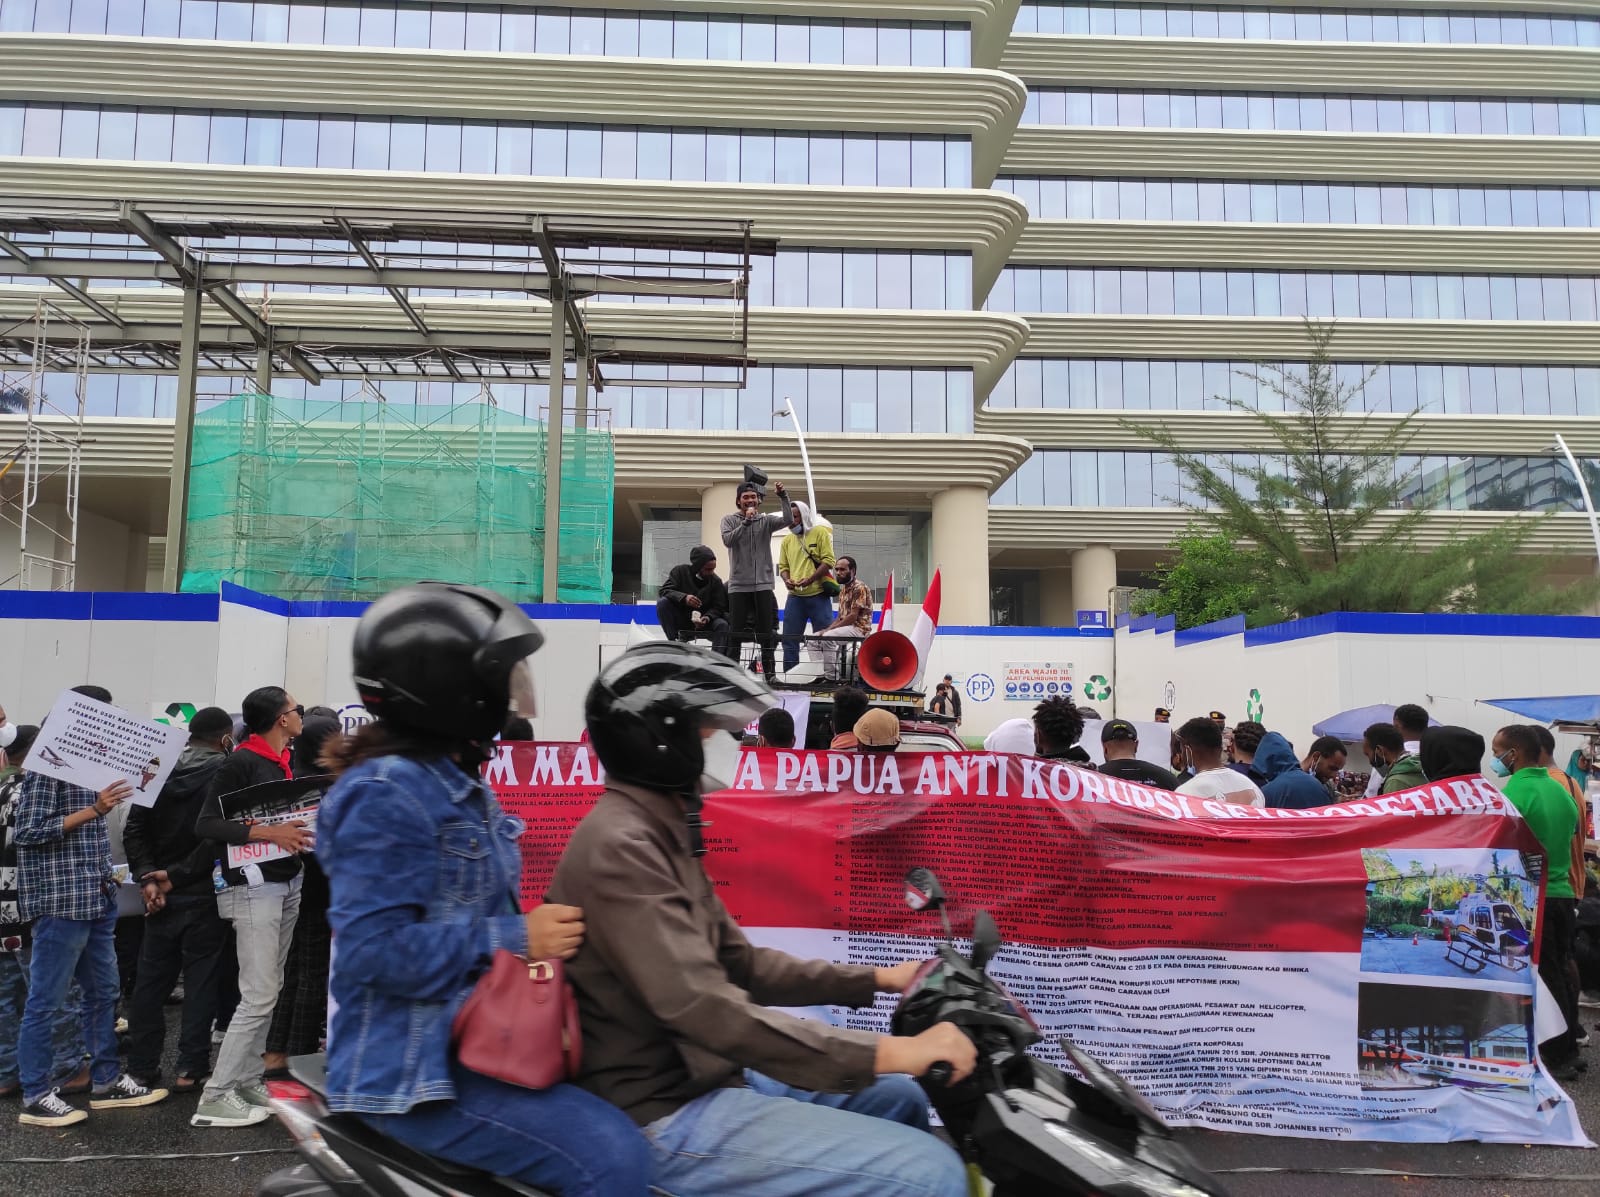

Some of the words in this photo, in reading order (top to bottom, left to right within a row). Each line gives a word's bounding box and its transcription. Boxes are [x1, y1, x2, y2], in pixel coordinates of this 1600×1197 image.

[972, 681, 990, 694] PP
[775, 752, 904, 794] PAPUA
[914, 756, 1009, 796] ANTI
[1021, 760, 1200, 820] KORUPSI
[869, 930, 906, 939] KADISHUB
[1018, 942, 1056, 952] JOHANNES
[998, 956, 1030, 965] TERBANG
[1091, 962, 1126, 970] CARAVAN
[1091, 976, 1116, 984] KARNA
[1090, 984, 1116, 992] GRAND
[1094, 1000, 1140, 1010] PENGADAAN
[1159, 1002, 1202, 1011] OPERASIONAL
[846, 1010, 887, 1018] HILANGNYA
[1160, 1011, 1220, 1020] PENYALAHGUNAAN
[1098, 1026, 1141, 1034] PENGADAAN
[1206, 1108, 1248, 1118] LANGSUNG
[1206, 1116, 1232, 1124] KAKAK
[1274, 1123, 1316, 1132] JOHANNES
